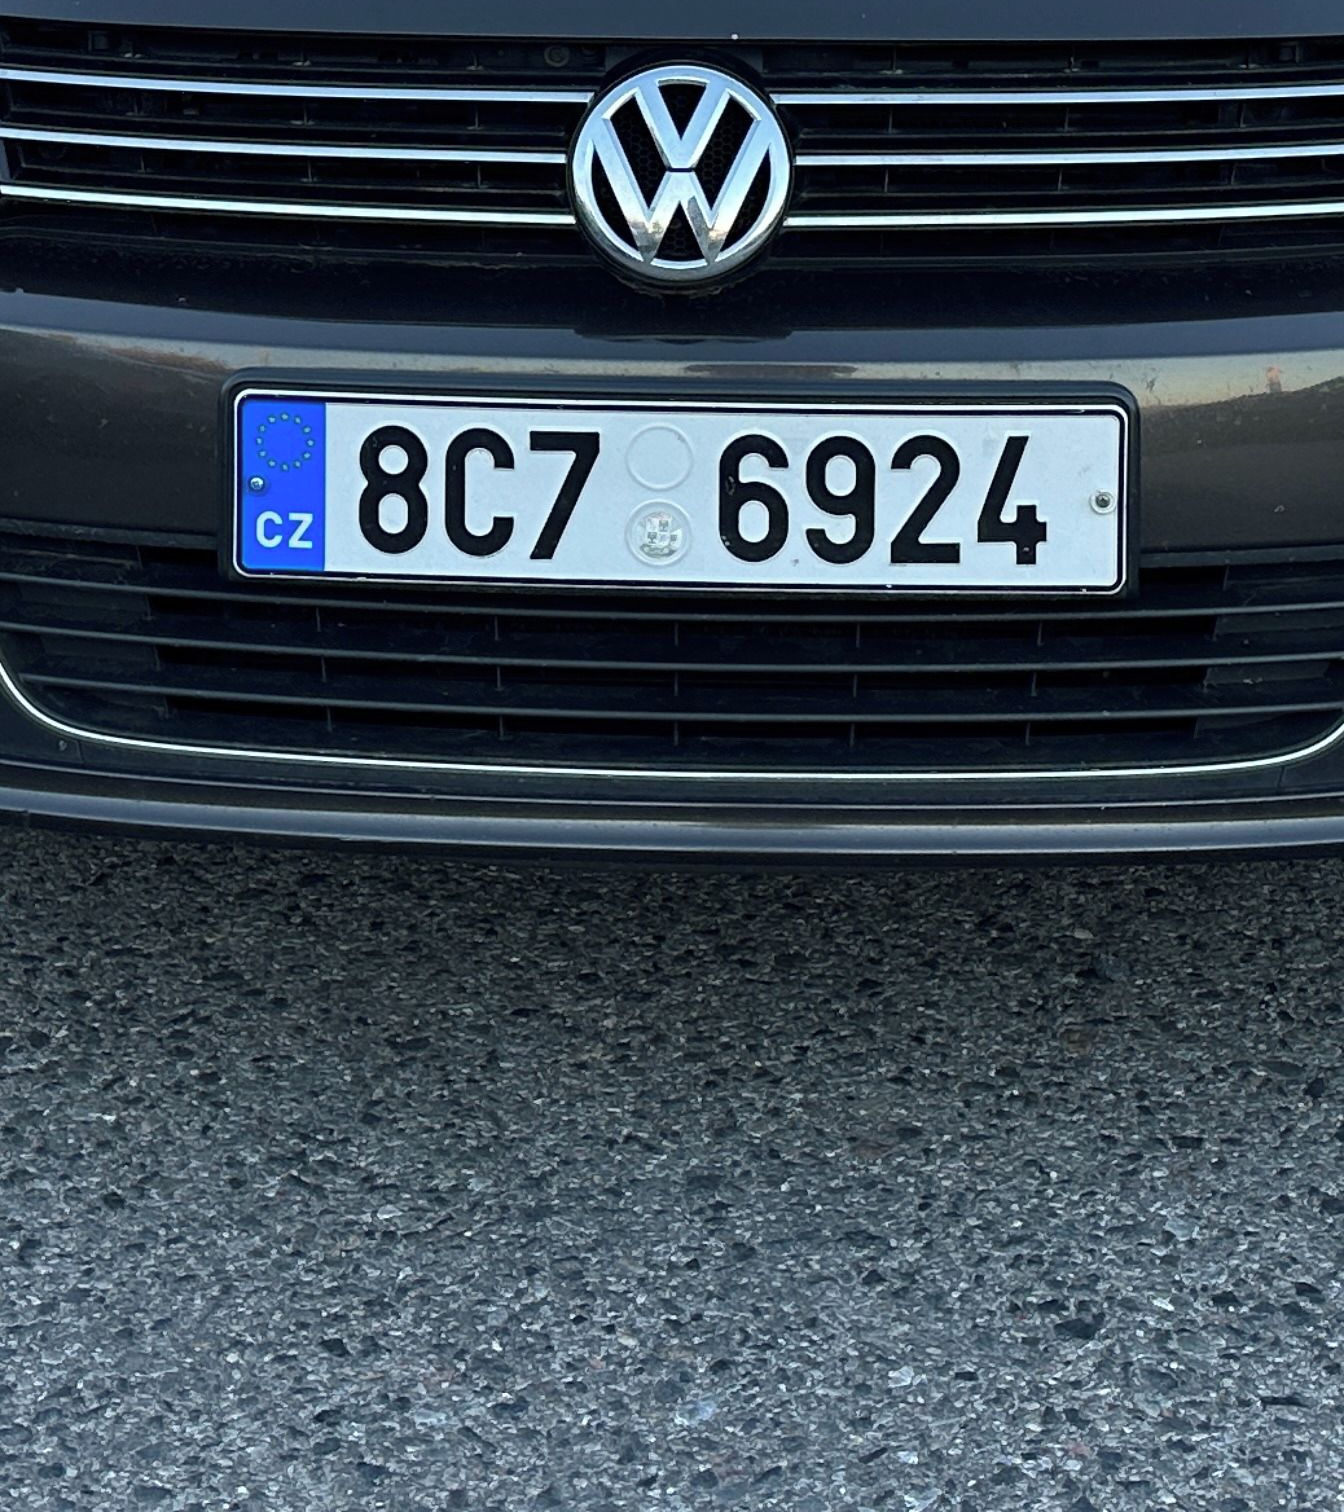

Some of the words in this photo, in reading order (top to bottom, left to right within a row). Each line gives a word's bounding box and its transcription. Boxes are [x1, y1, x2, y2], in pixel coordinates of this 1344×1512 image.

[255, 510, 314, 552] CZ
[357, 423, 601, 561] 8C7
[717, 432, 1049, 566] 6924
